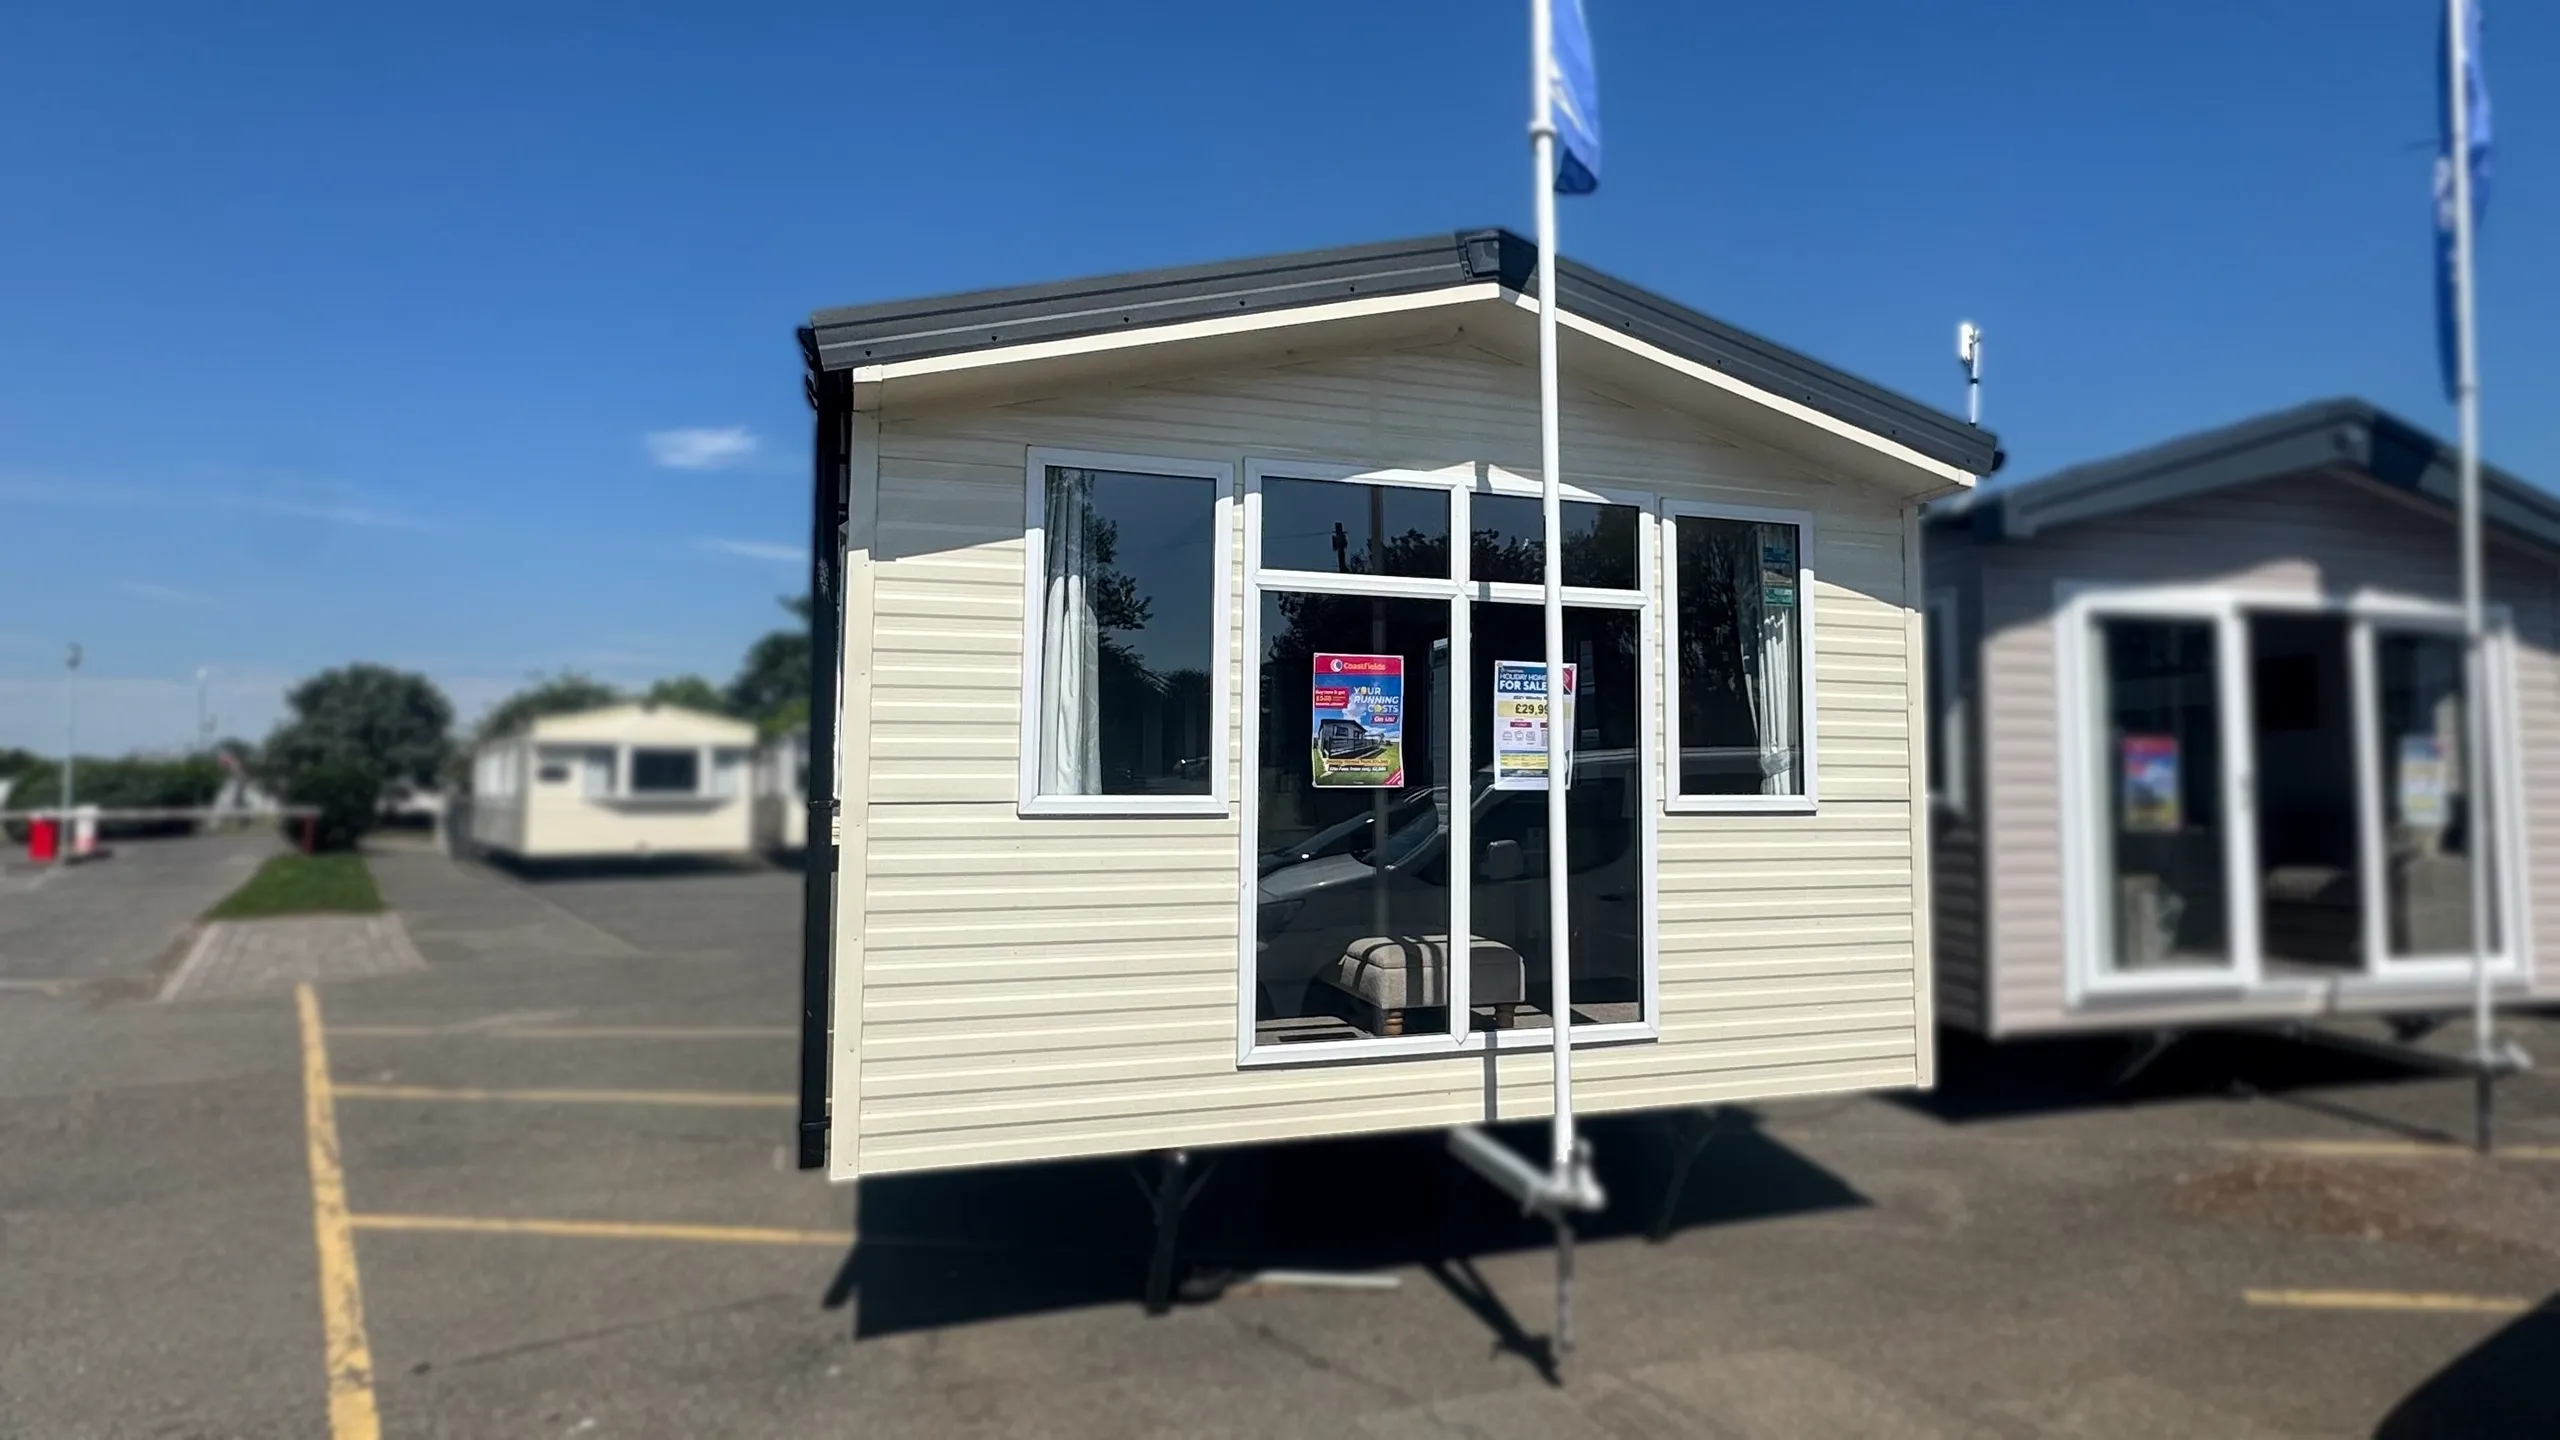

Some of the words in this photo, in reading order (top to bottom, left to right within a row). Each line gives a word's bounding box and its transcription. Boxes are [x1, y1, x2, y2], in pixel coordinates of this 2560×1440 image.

[1499, 680, 1521, 691] FOR
[1523, 681, 1548, 691] SALE
[1353, 686, 1382, 696] YOUR
[1353, 695, 1400, 704] RUNNING
[1367, 704, 1400, 713] COSTS
